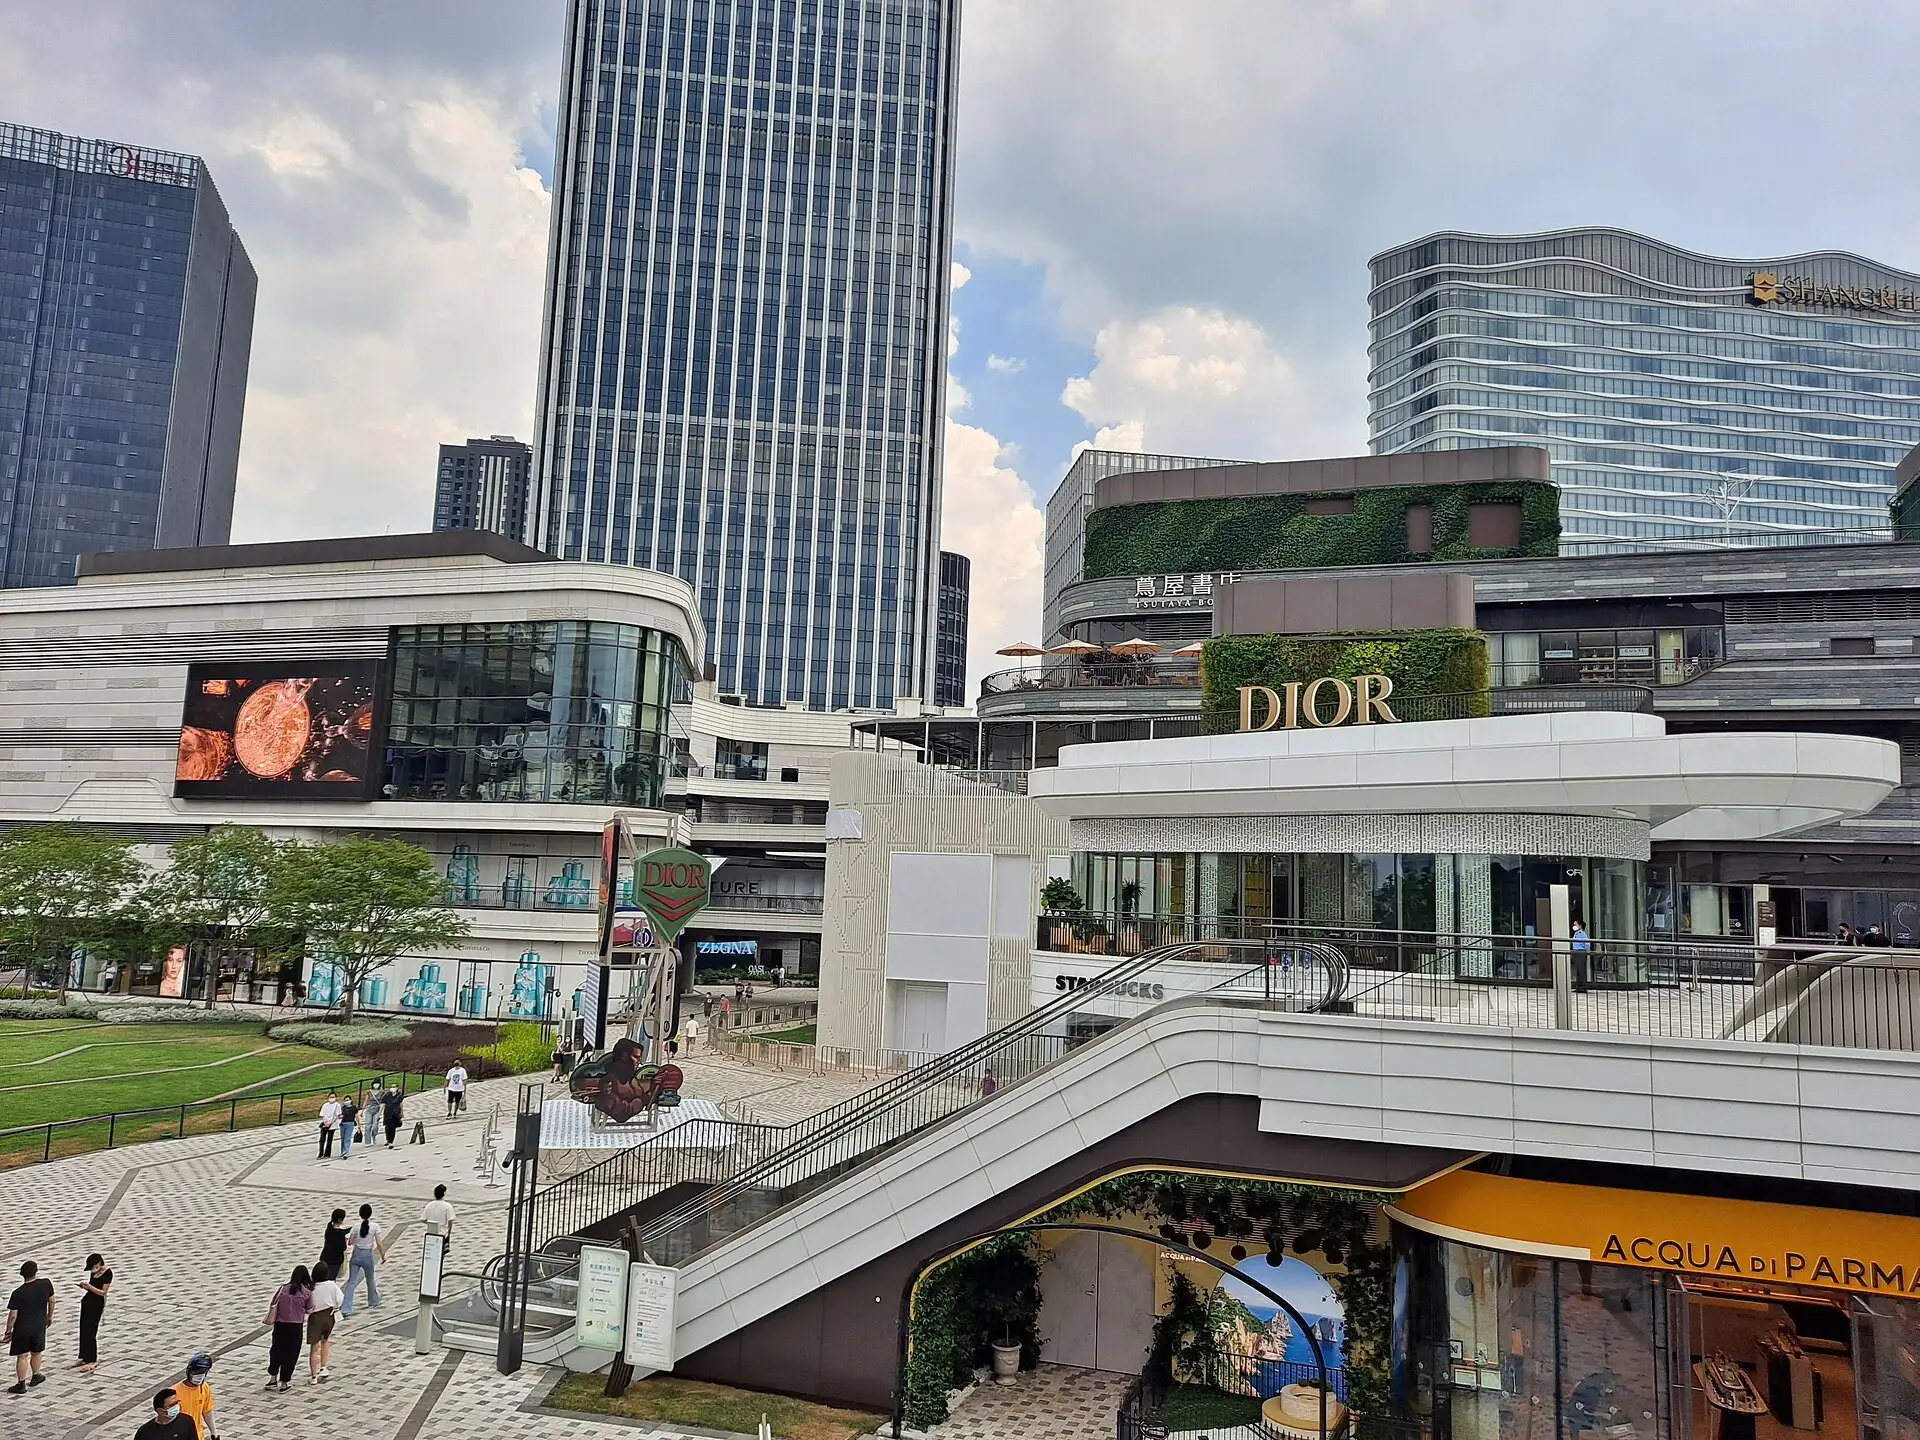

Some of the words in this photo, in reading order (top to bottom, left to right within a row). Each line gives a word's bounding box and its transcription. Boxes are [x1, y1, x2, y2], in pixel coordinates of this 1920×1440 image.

[1135, 599, 1191, 609] TSUTAYA
[1234, 674, 1402, 733] DIOR
[643, 862, 706, 889] DIOR
[699, 942, 753, 955] ZEGNA
[1055, 975, 1164, 1000] STAUCKS
[1601, 1234, 1742, 1273] ACQUA
[1750, 1255, 1777, 1275] DI
